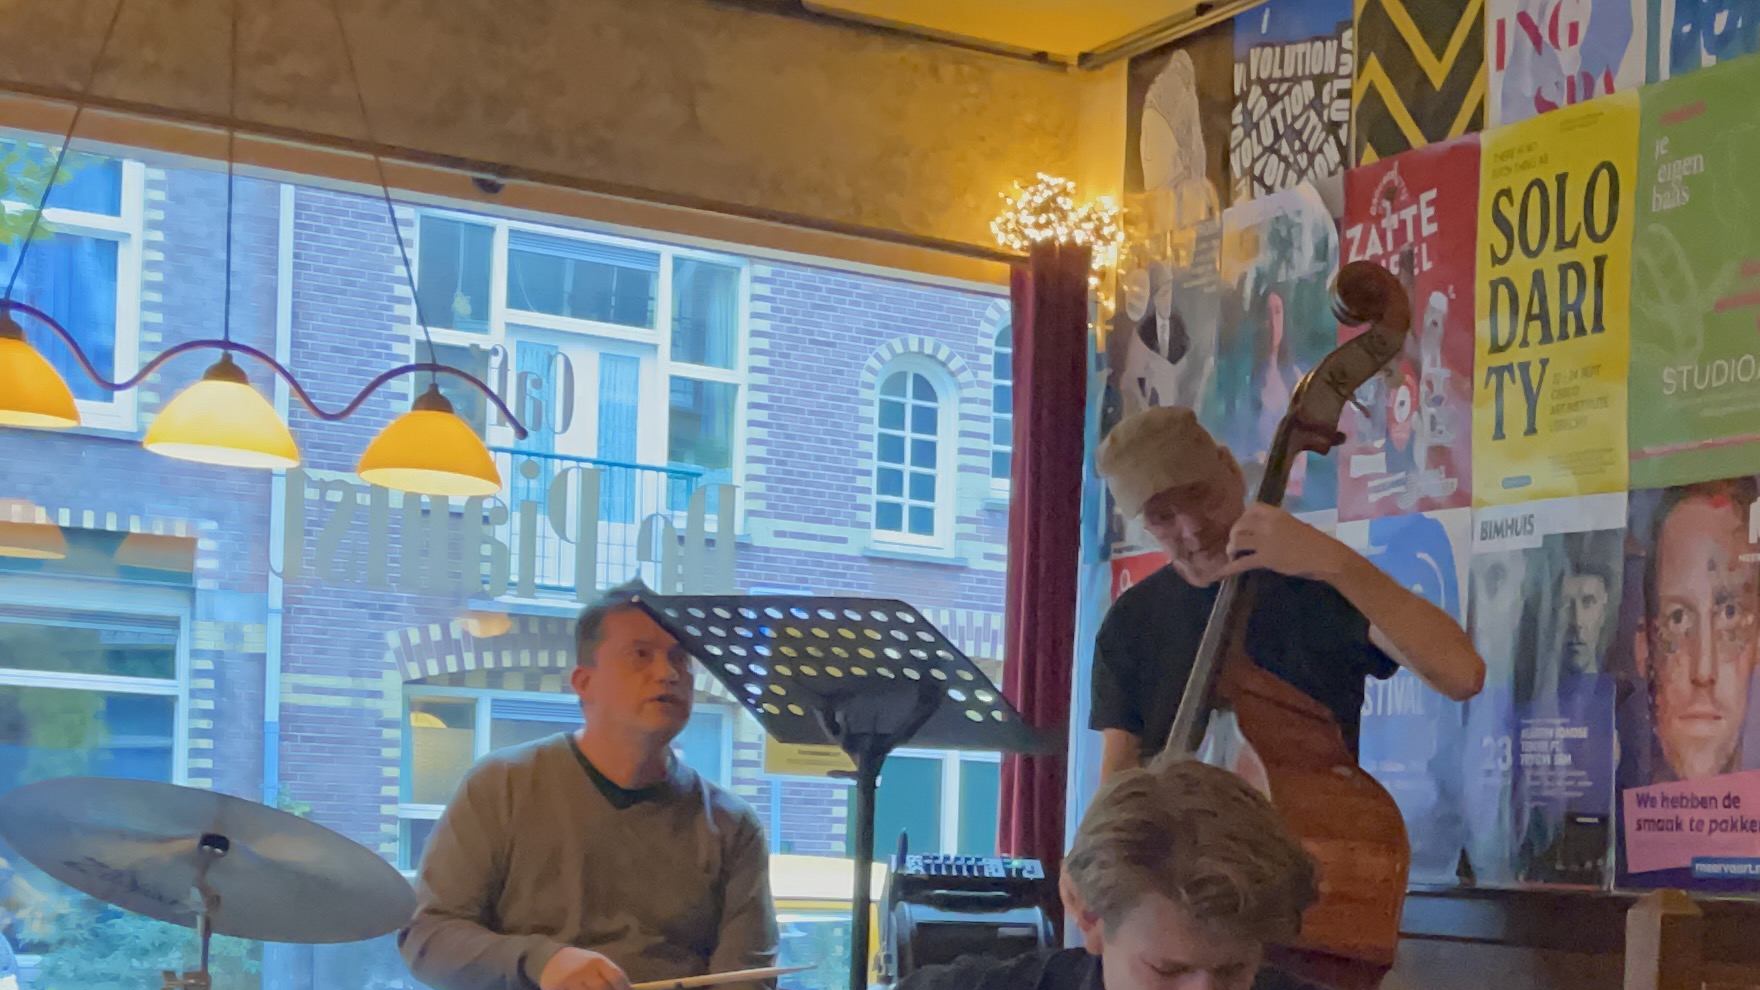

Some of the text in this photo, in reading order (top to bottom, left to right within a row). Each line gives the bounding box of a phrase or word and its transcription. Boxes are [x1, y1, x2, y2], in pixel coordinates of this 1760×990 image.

[1346, 187, 1438, 264] ZATTE
[1489, 160, 1620, 268] SOLO
[1488, 254, 1608, 355] DARI
[1484, 357, 1550, 441] TY
[1480, 513, 1535, 541] BIMHUIS
[1635, 791, 1741, 810] We hebben de
[1635, 815, 1684, 832] smaak
[1689, 817, 1705, 833] te
